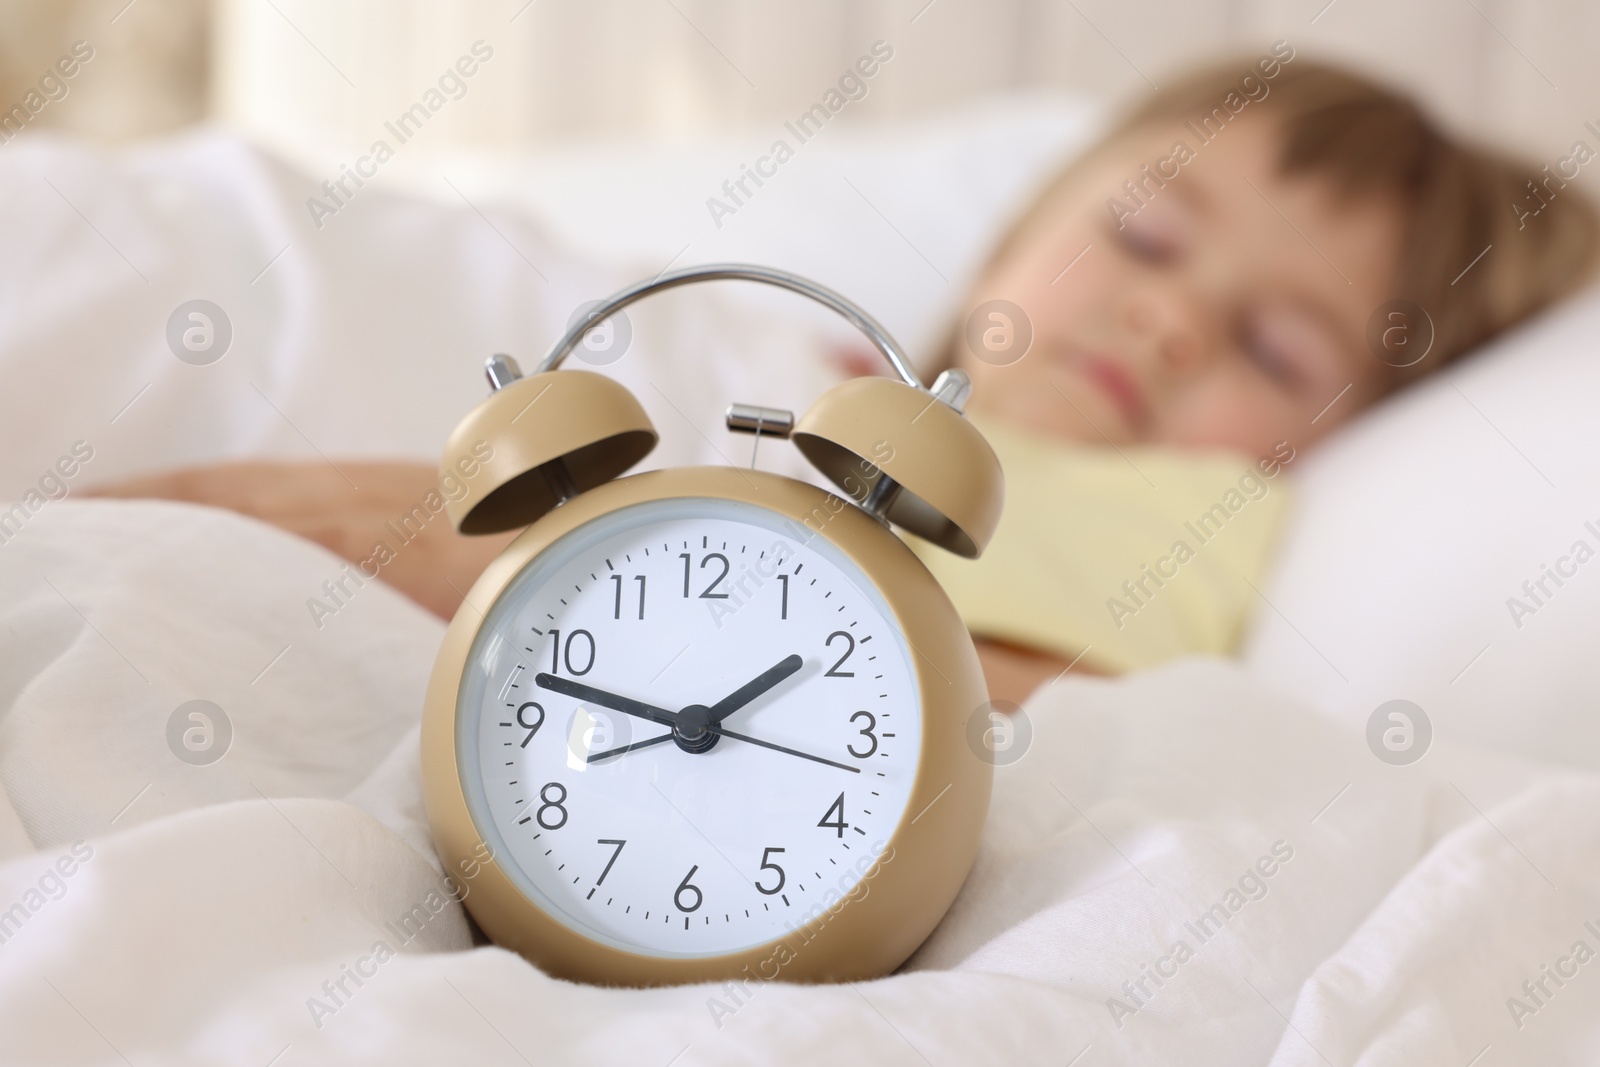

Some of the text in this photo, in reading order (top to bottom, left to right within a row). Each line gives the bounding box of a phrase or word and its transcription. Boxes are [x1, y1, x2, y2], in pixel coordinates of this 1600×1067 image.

[610, 574, 646, 620] 11
[679, 553, 730, 599] 12
[776, 574, 789, 620] 1
[547, 629, 596, 677] 10
[823, 630, 855, 678] 2
[516, 701, 545, 749] 9
[847, 710, 878, 759] 3
[536, 782, 568, 831] 8
[816, 791, 849, 839] 4
[597, 839, 627, 887] 7
[754, 847, 786, 896] 5
[673, 864, 703, 913] 6
